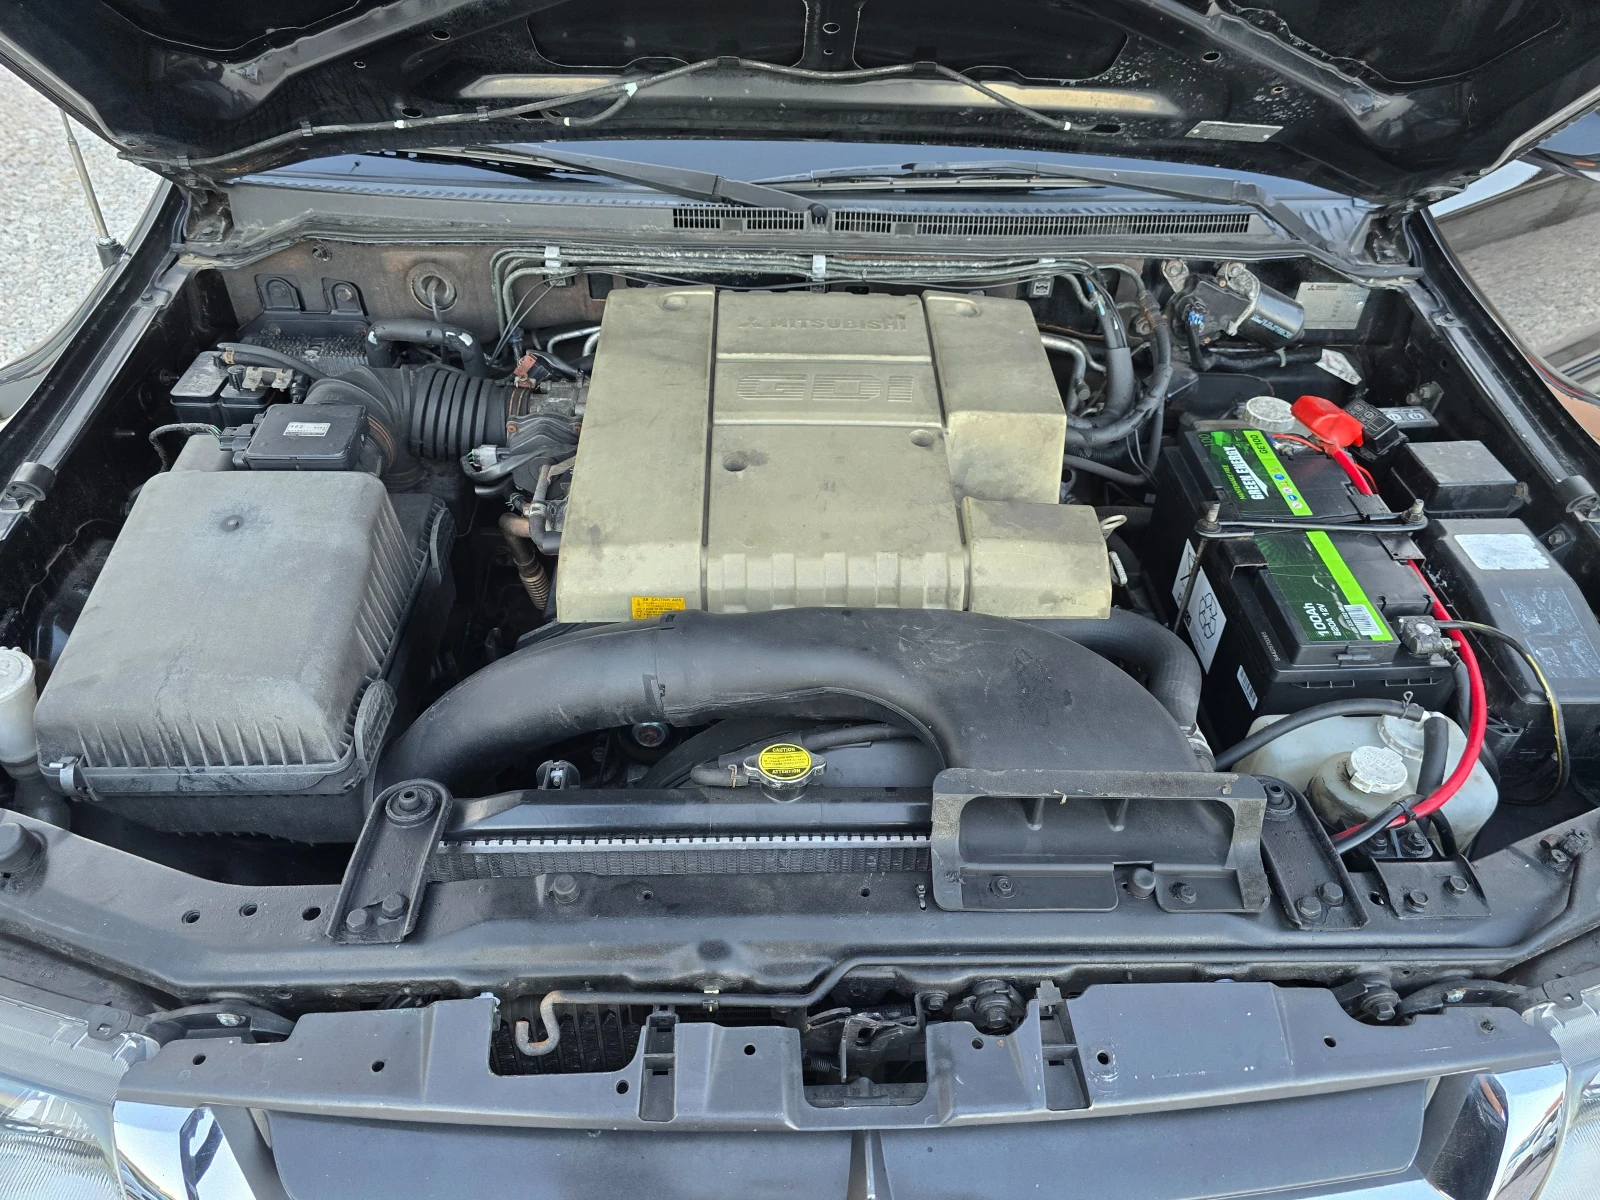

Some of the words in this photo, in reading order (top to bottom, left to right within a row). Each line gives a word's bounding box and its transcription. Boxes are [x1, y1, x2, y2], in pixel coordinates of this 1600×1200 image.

[770, 317, 907, 331] MITSUBISHI
[736, 373, 914, 402] GDI
[1250, 434, 1268, 454] GE100
[1222, 446, 1249, 473] ENERGY
[1239, 475, 1266, 500] GREEN
[1303, 602, 1330, 637] 100Ah
[1316, 603, 1331, 617] 12V
[1326, 617, 1342, 636] 820A
